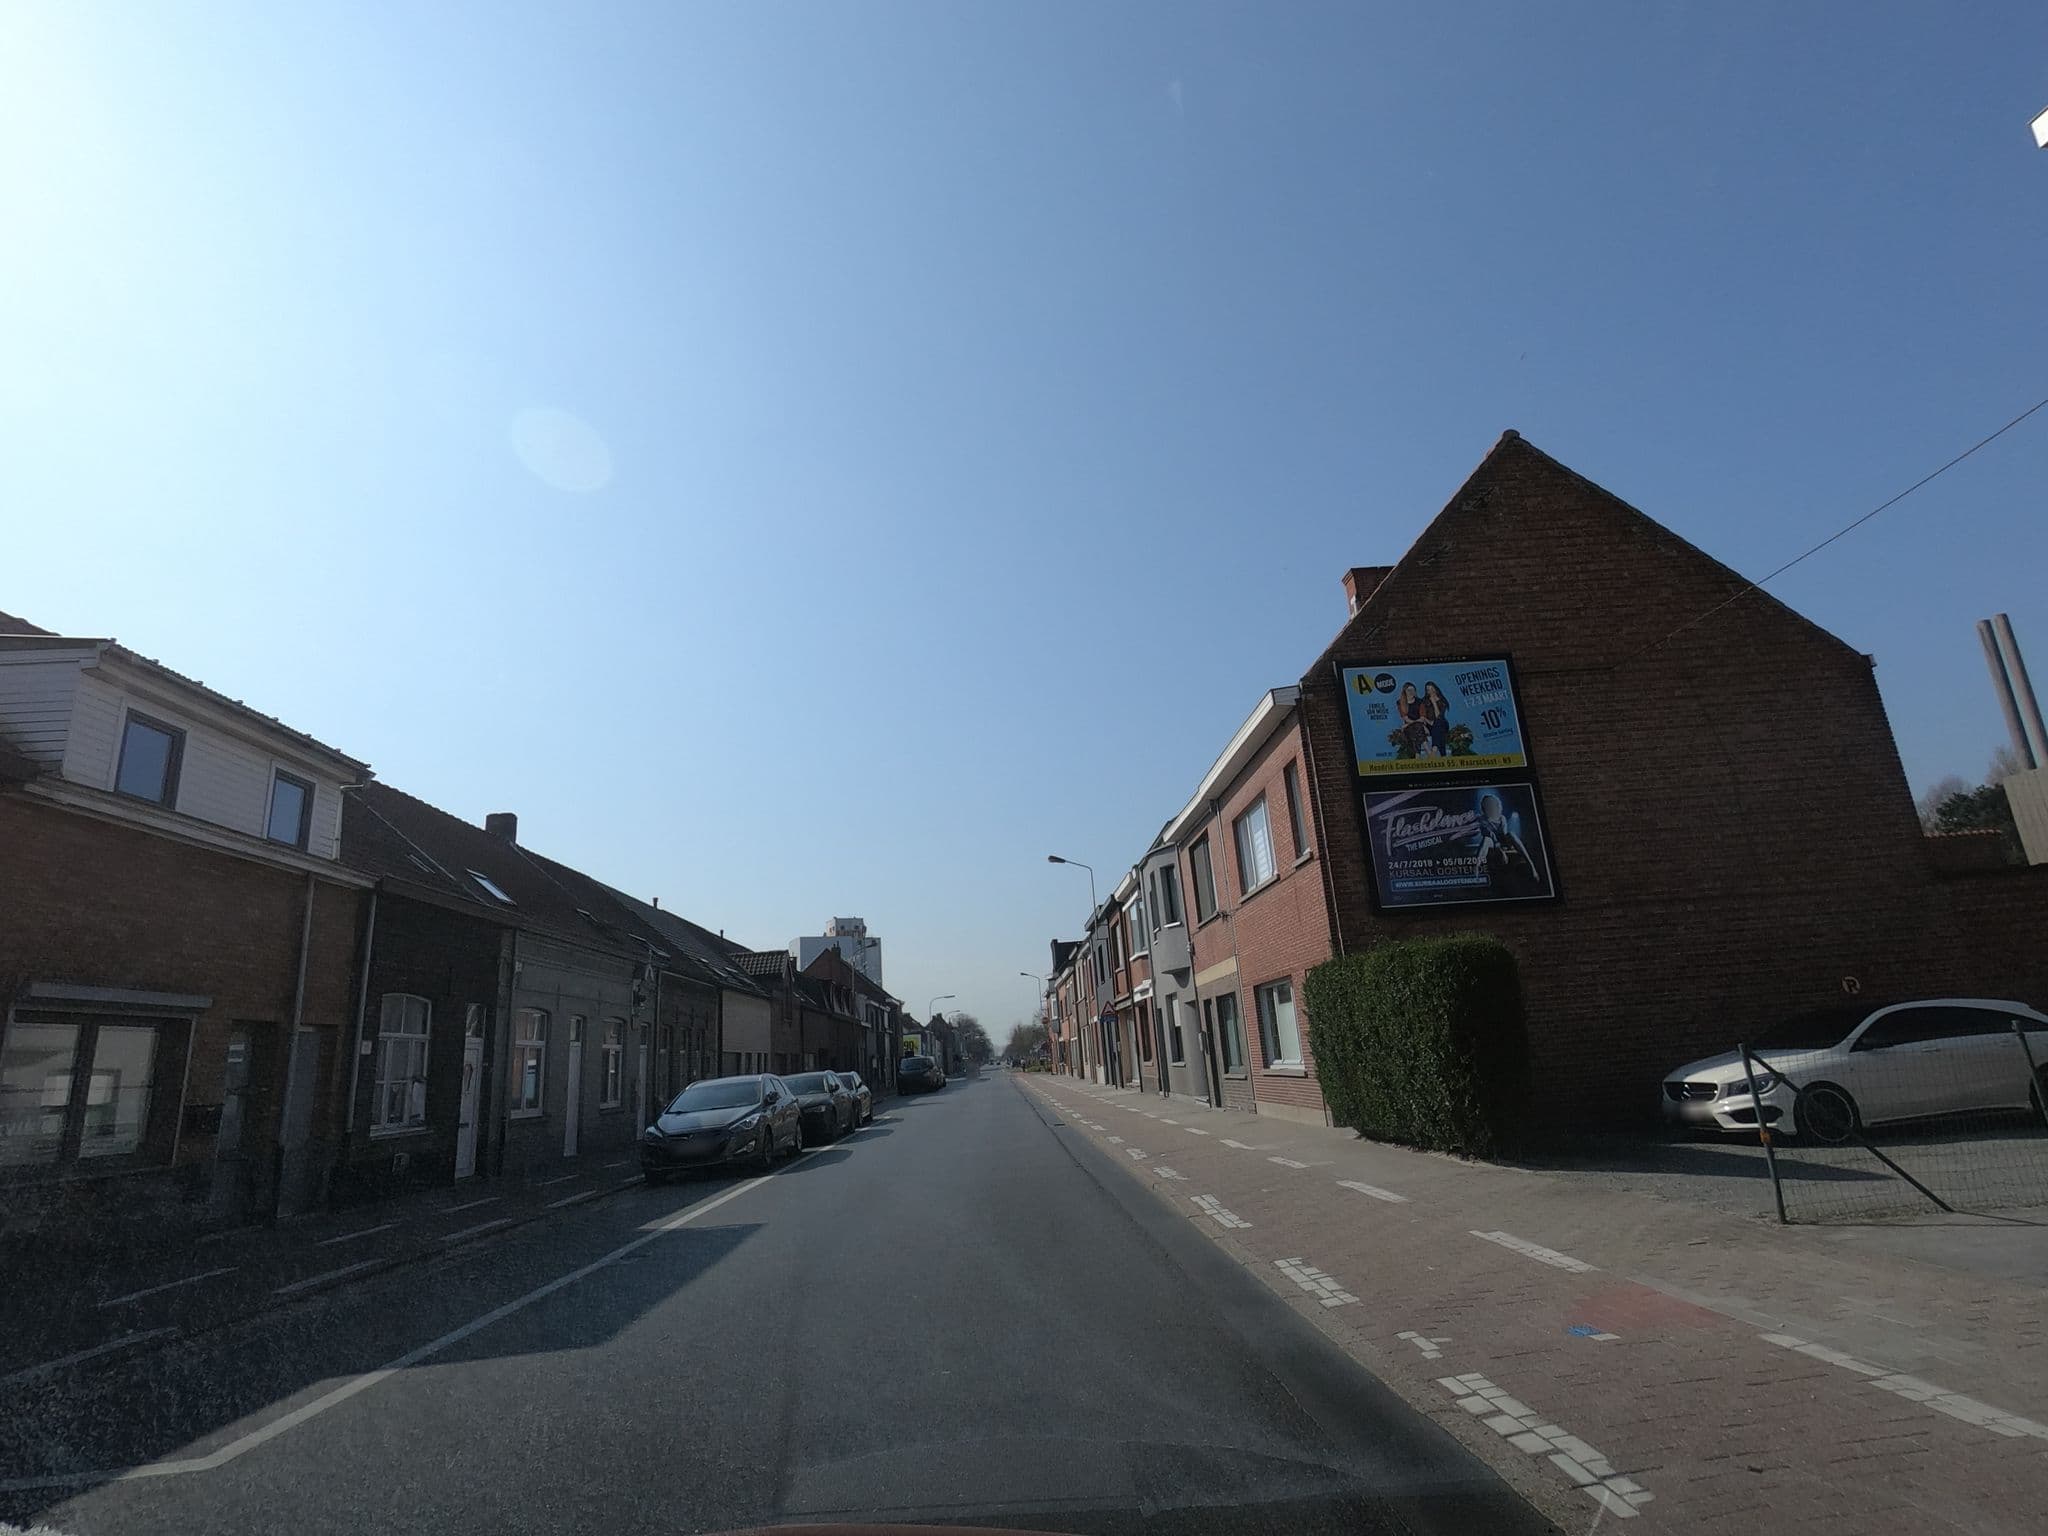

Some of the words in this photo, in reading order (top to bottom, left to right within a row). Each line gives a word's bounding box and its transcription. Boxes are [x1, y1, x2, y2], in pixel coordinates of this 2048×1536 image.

[1455, 667, 1500, 685] OPENINGS
[1460, 679, 1503, 697] WEEKEND
[1369, 762, 1393, 772] Hendrik
[1378, 806, 1478, 856] Flashdance
[1405, 843, 1418, 851] THE
[1418, 836, 1442, 849] MUSICAL
[1388, 859, 1433, 869] 24/7/2018
[1388, 867, 1437, 878] KURSAAL
